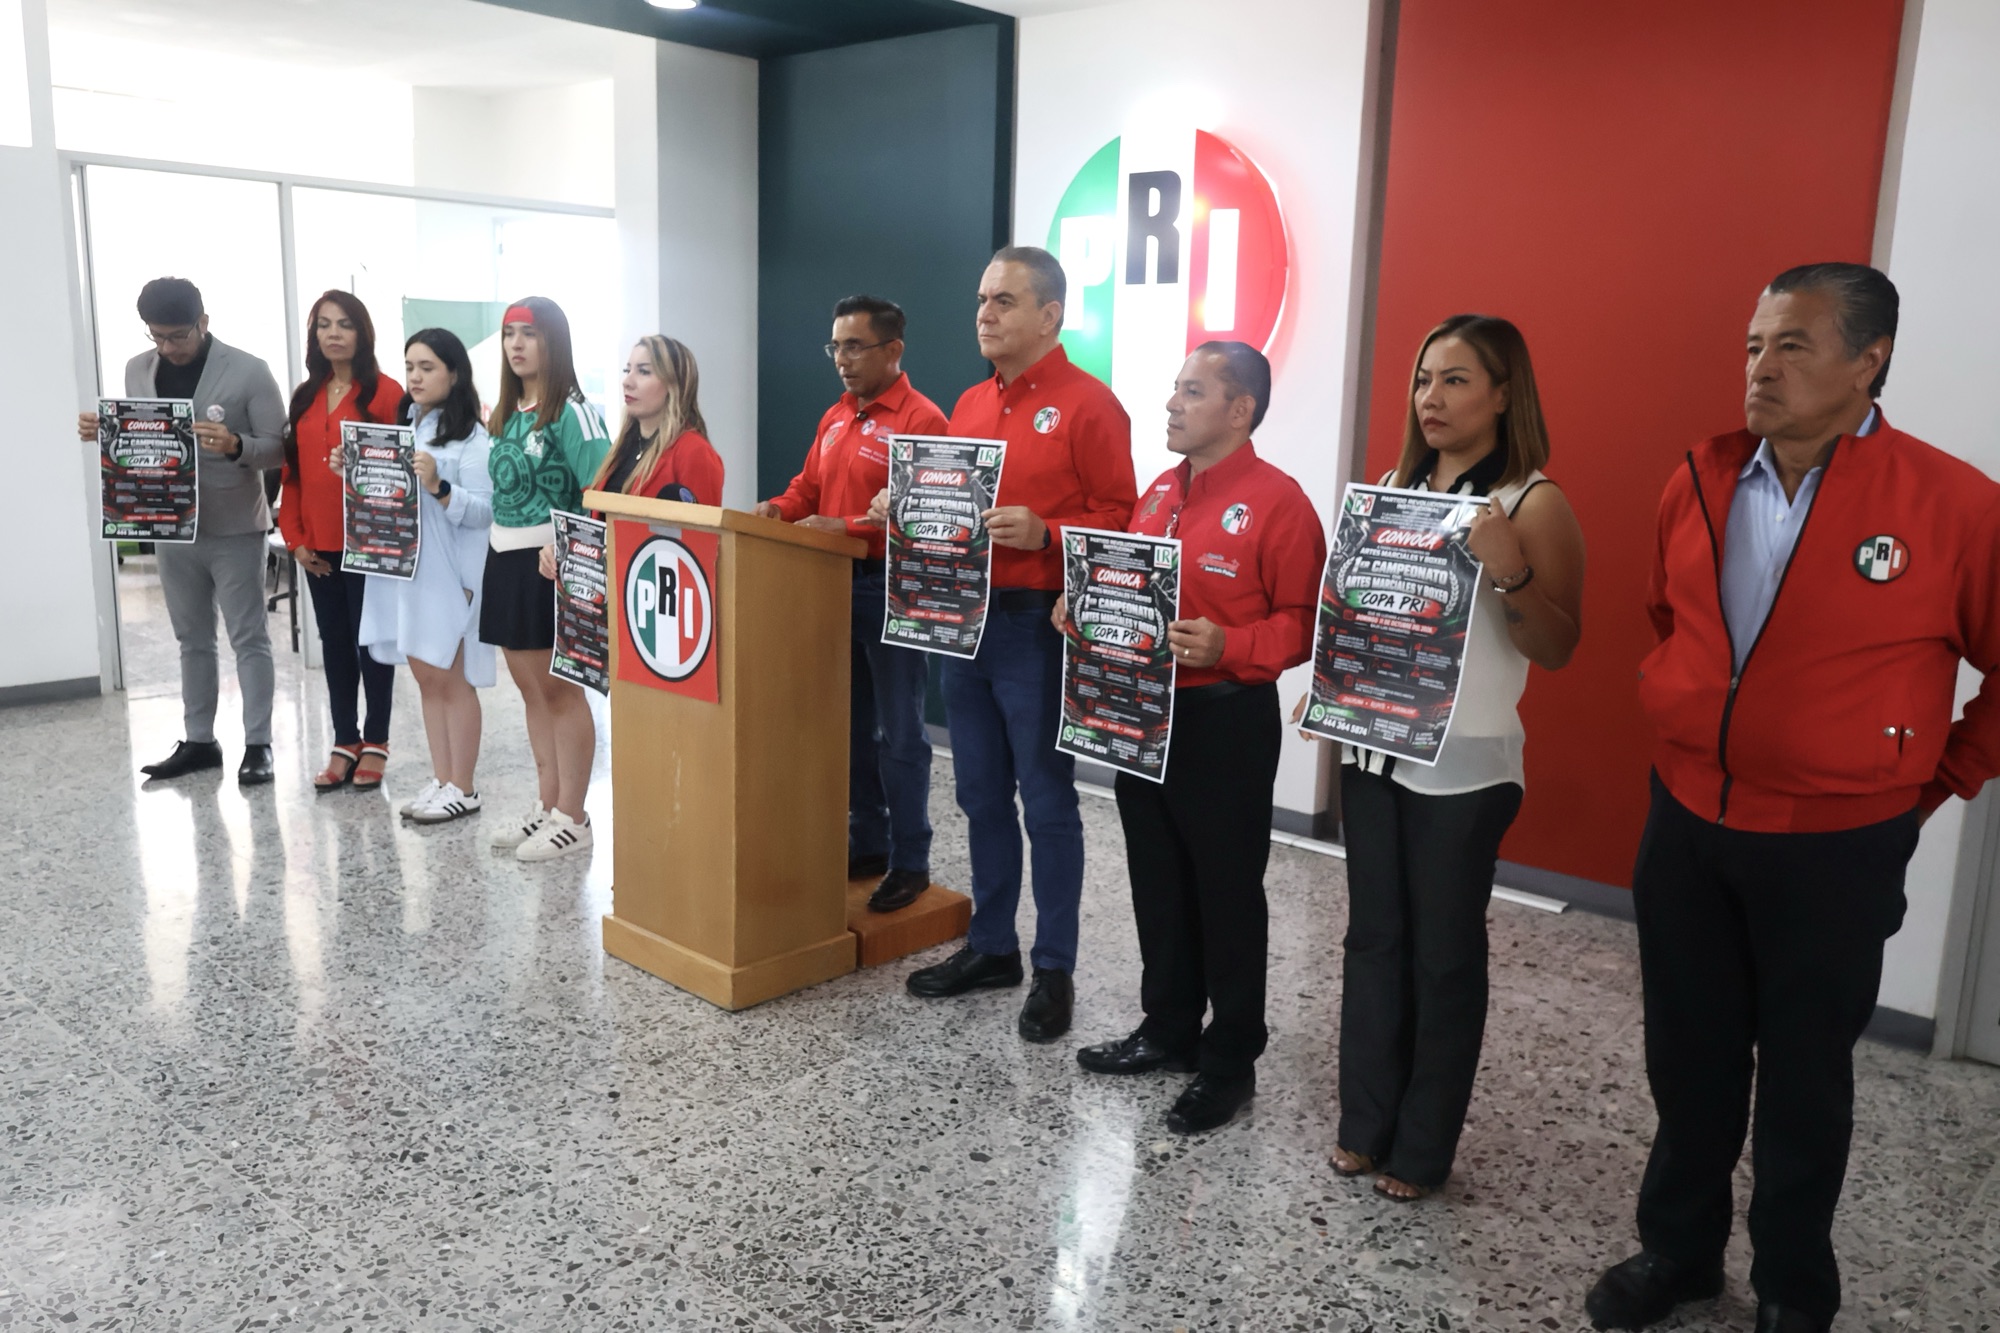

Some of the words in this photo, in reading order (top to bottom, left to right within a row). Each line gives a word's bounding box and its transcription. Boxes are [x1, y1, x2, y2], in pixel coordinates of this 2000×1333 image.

[1059, 170, 1240, 331] PRI
[127, 421, 166, 432] CONVOCA
[1036, 411, 1058, 427] PRI
[364, 448, 395, 460] CONVOCA
[980, 449, 995, 462] IR
[920, 471, 962, 486] CONVOCA
[919, 498, 972, 513] CAMPEONATO
[1222, 507, 1249, 530] PRI
[1377, 529, 1440, 550] CONVOCA
[573, 542, 599, 559] CONVOCA
[1156, 548, 1171, 563] IR
[1360, 547, 1380, 556] ARTES
[1381, 550, 1418, 561] MARCIALES
[1424, 555, 1447, 566] BOXEO
[1859, 542, 1901, 569] PRI
[1097, 568, 1141, 588] CONVOCA
[1371, 560, 1449, 585] CAMPEONATO
[1345, 575, 1371, 588] ARTES
[1371, 576, 1416, 594] MARCIALES
[1416, 584, 1422, 595] Y
[1422, 585, 1449, 604] BOXEO
[637, 565, 694, 640] PRI
[1098, 595, 1155, 620] CAMPEONATO
[1323, 717, 1335, 728] 444
